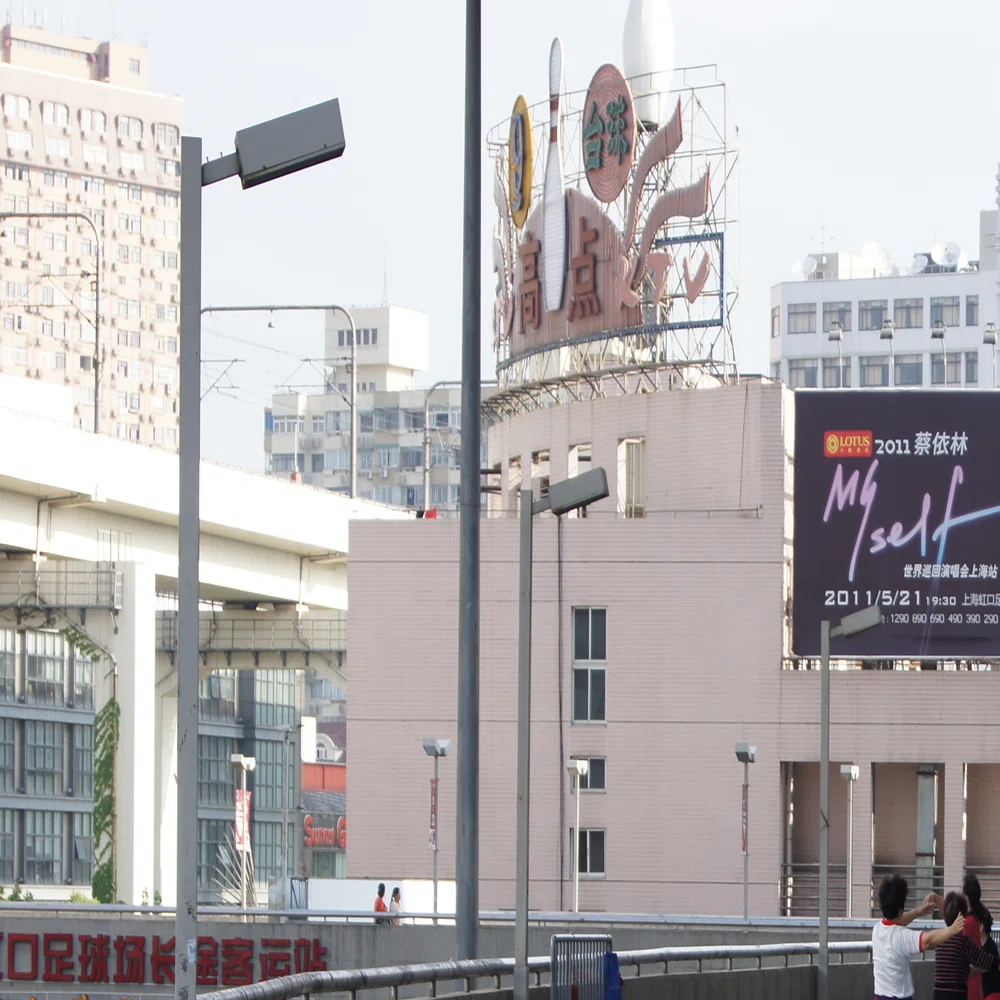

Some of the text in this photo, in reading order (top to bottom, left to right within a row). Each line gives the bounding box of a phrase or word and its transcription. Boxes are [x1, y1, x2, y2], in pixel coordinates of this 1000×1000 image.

[840, 436, 870, 446] LOTUS
[875, 431, 969, 455] 2011 蔡依林
[903, 563, 999, 579] 世界巡回演唱会上海站
[824, 589, 921, 606] 2011/5/21
[926, 596, 957, 606] 19:30
[890, 613, 910, 624] 1290
[911, 613, 928, 624] 890
[929, 613, 945, 624] 690
[947, 613, 963, 624] 490
[965, 613, 981, 624] 390
[983, 613, 999, 625] 290
[0, 932, 328, 986] 口足球场长途客运站
